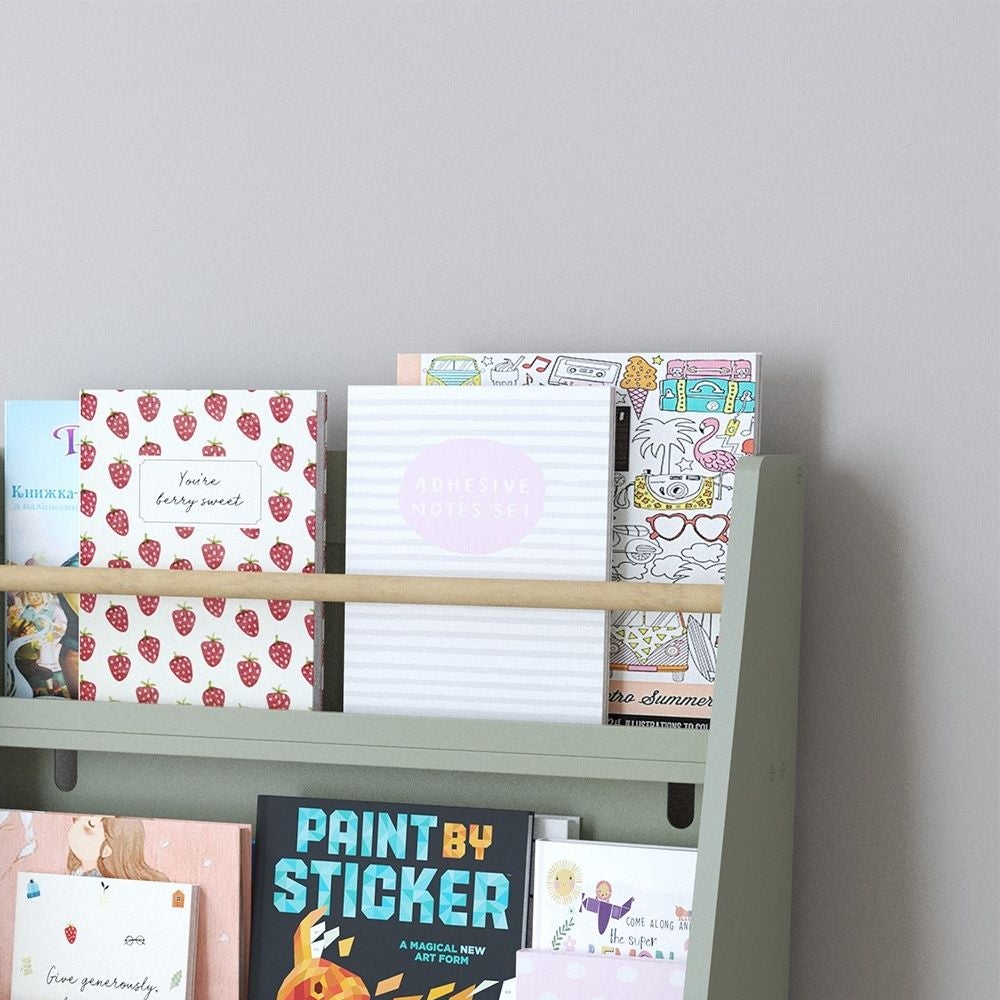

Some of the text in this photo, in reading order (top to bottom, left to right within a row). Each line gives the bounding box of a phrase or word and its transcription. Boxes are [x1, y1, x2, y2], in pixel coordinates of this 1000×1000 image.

[179, 470, 221, 487] You're
[416, 478, 530, 494] ADHESIVE
[156, 492, 244, 513] berry sweet
[411, 502, 532, 519] NOTES SET
[296, 807, 493, 861] PAINT BY
[273, 857, 510, 930] STICKER
[626, 916, 691, 931] COME ALONG AN
[610, 928, 657, 949] the super
[399, 940, 486, 956] A MAGICAL NEW
[415, 953, 469, 965] ART FORM
[46, 965, 78, 985] Give
